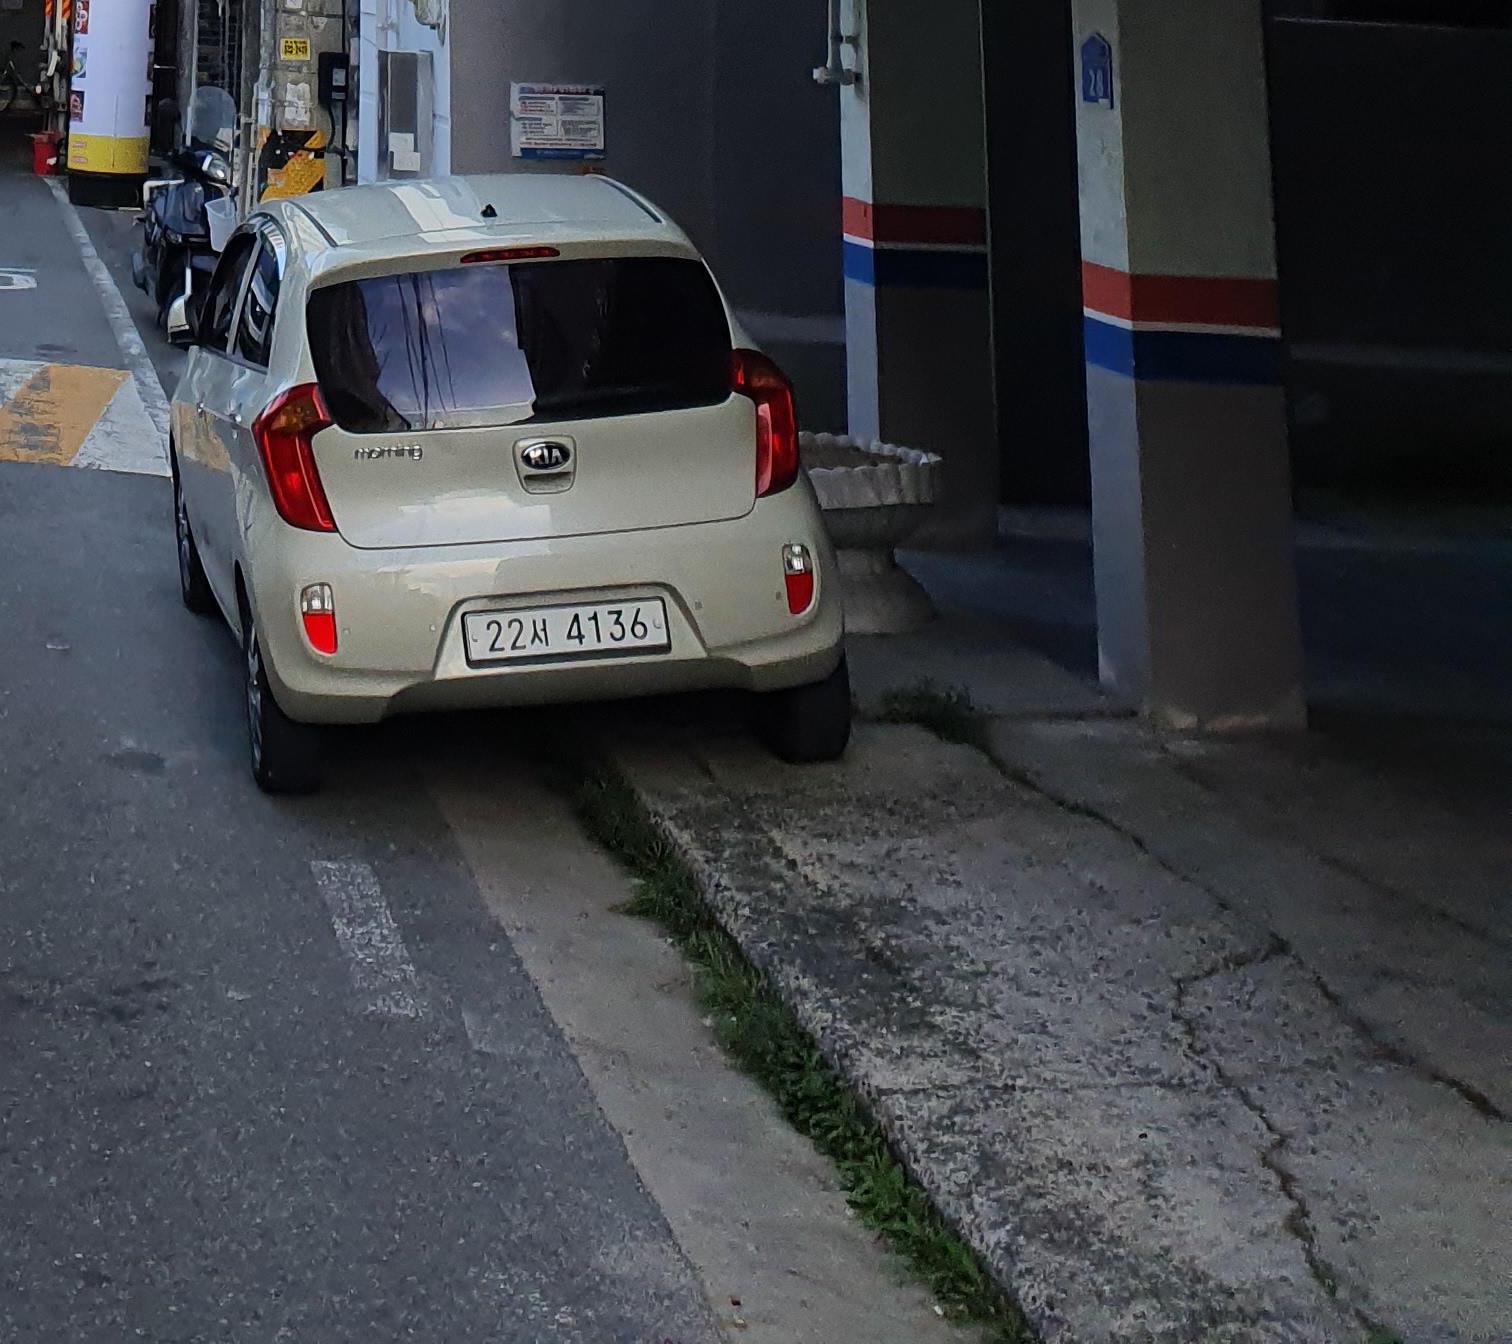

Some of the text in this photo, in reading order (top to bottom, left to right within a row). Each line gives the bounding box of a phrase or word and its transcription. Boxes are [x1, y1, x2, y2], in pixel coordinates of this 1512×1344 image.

[529, 447, 564, 465] KIA
[485, 607, 649, 653] 22서 4136
